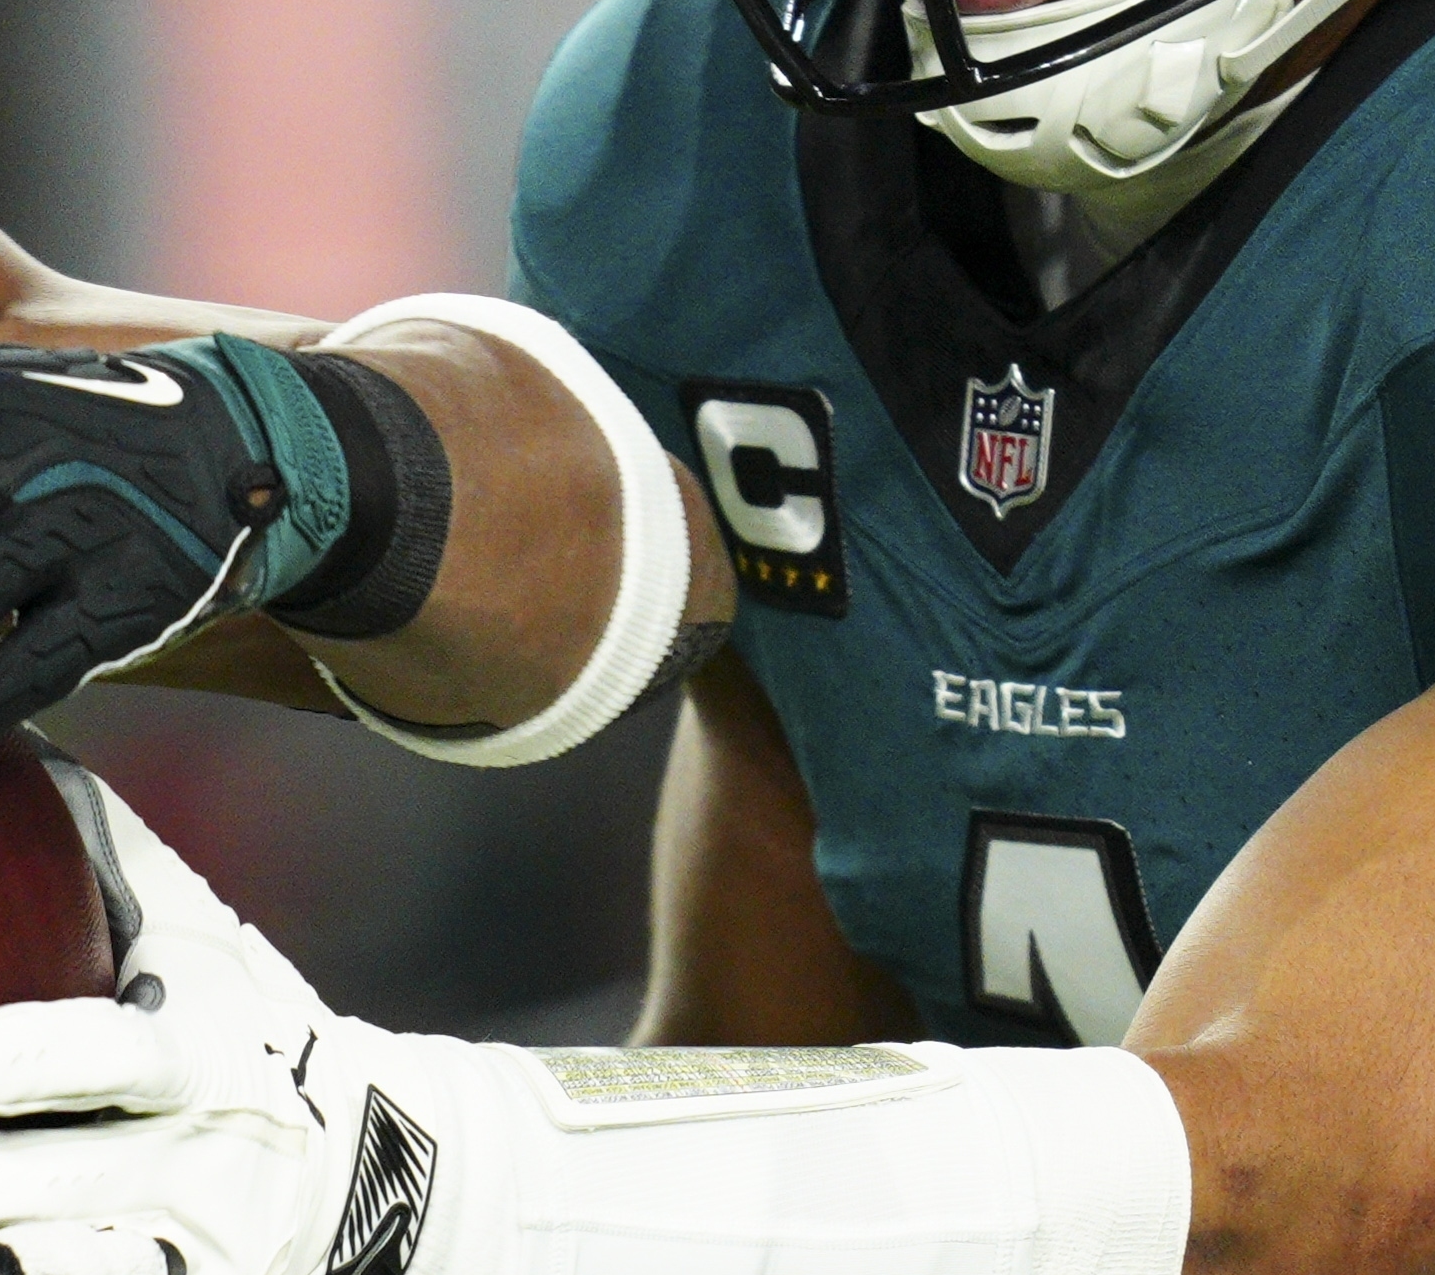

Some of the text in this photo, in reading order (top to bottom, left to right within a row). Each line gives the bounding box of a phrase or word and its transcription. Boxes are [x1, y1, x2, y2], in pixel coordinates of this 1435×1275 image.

[694, 397, 828, 555] C
[973, 431, 1033, 491] NFL
[931, 668, 1127, 739] EAGLES
